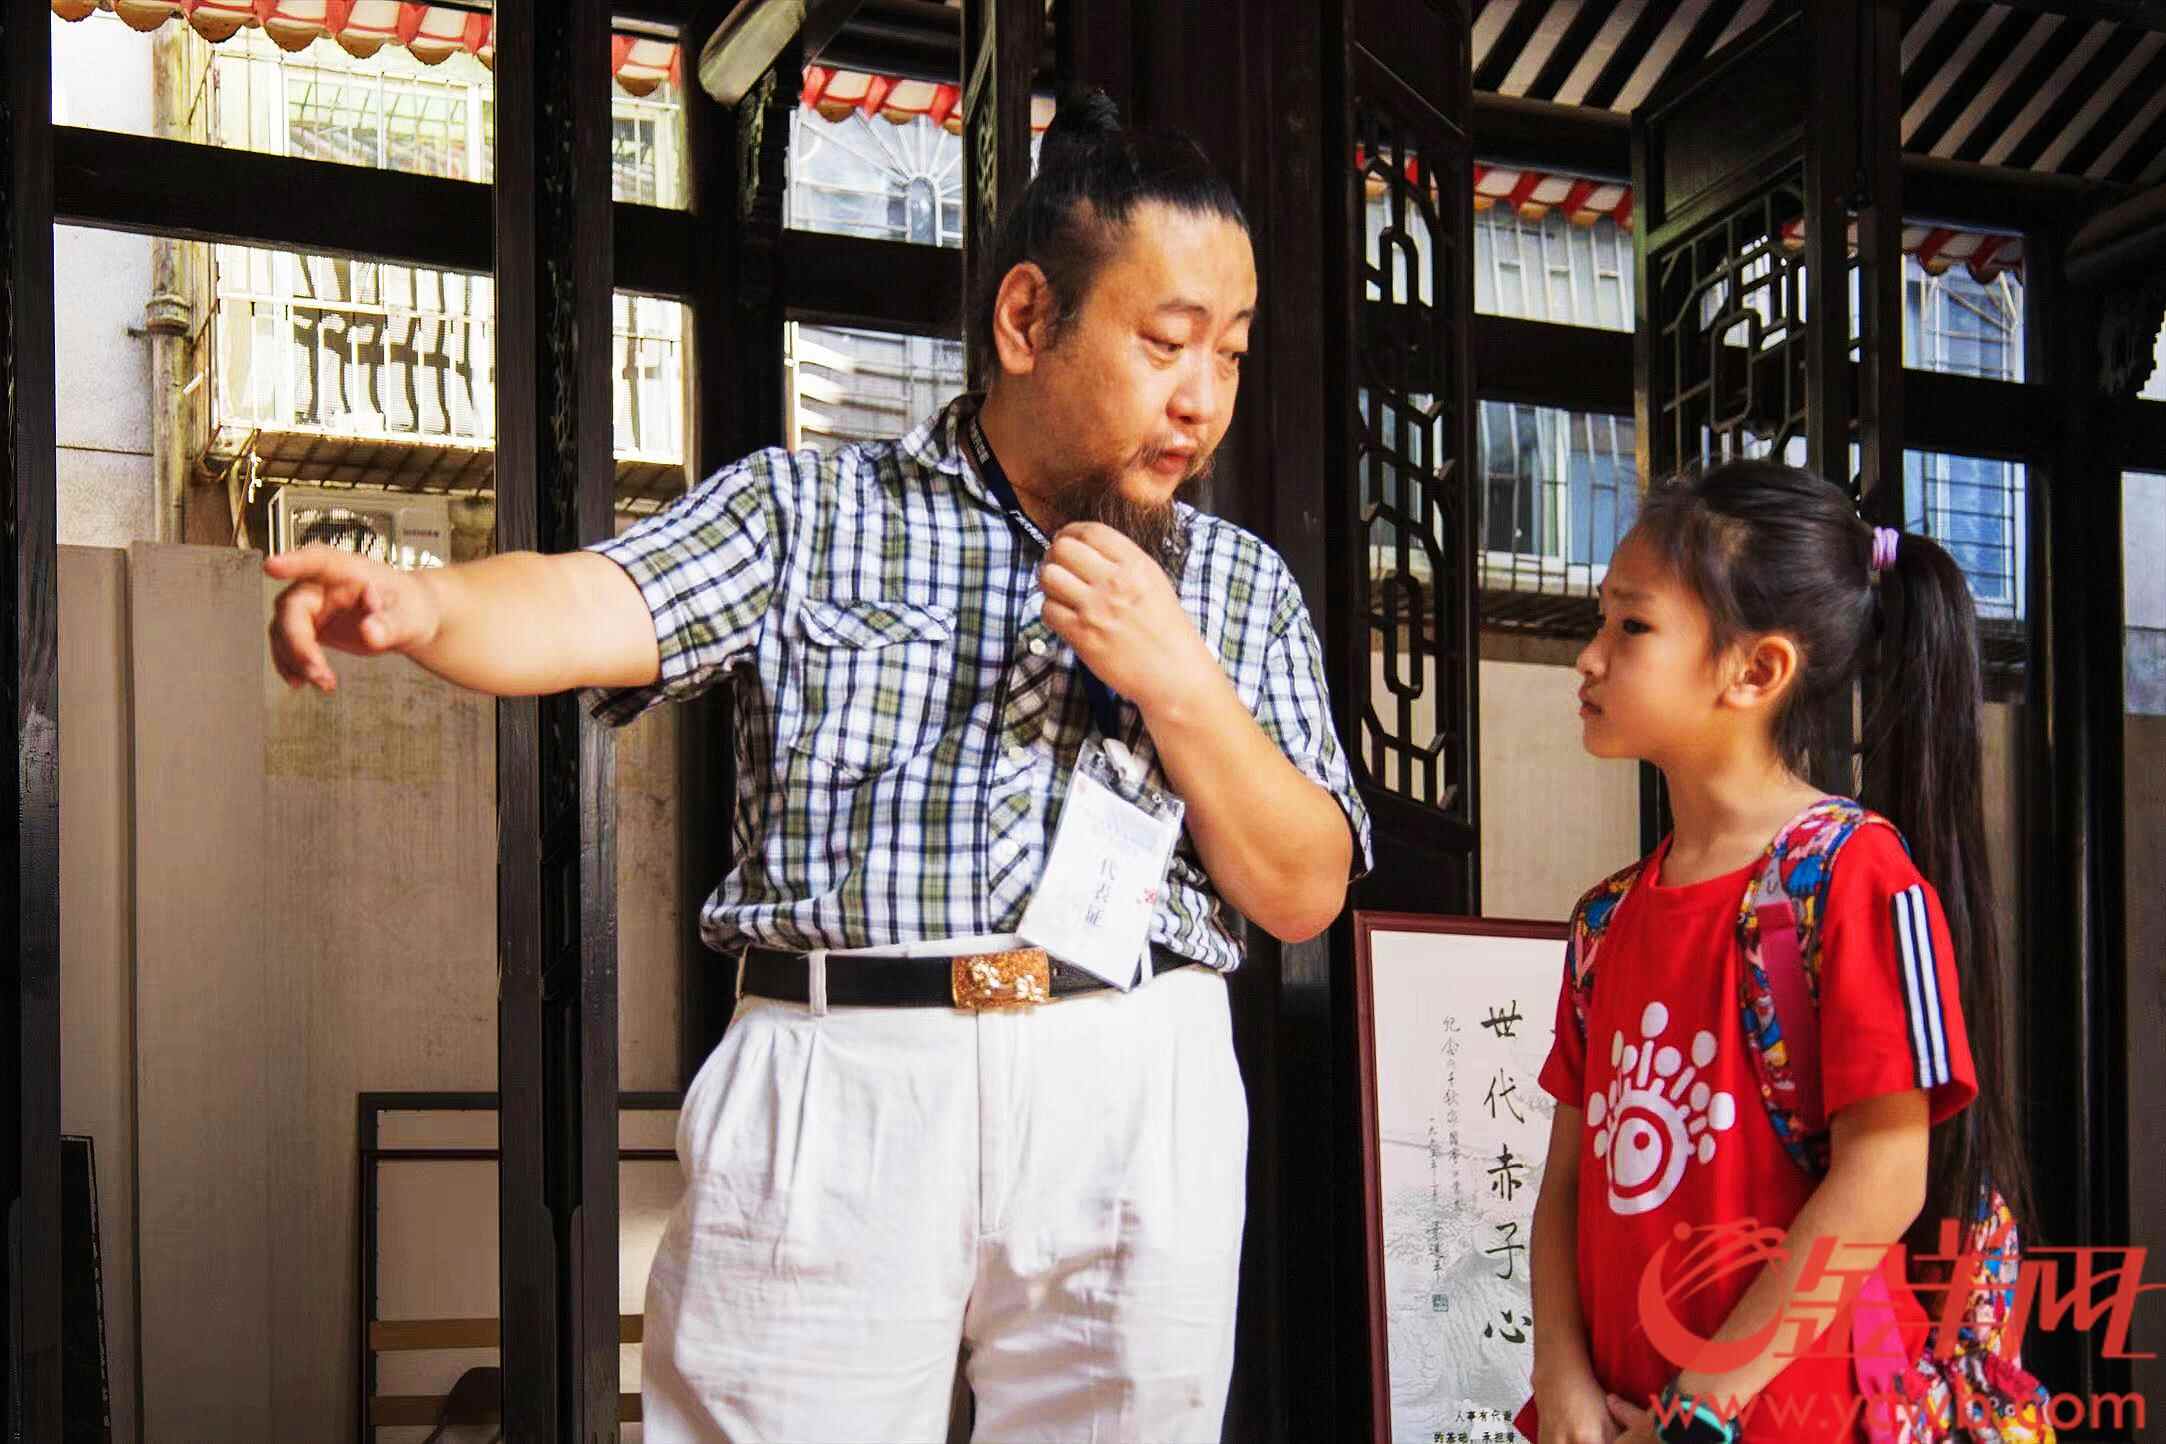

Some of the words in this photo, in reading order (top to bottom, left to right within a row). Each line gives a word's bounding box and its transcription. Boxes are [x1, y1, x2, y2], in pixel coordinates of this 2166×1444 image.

[1480, 999, 1532, 1344] 世代赤子心
